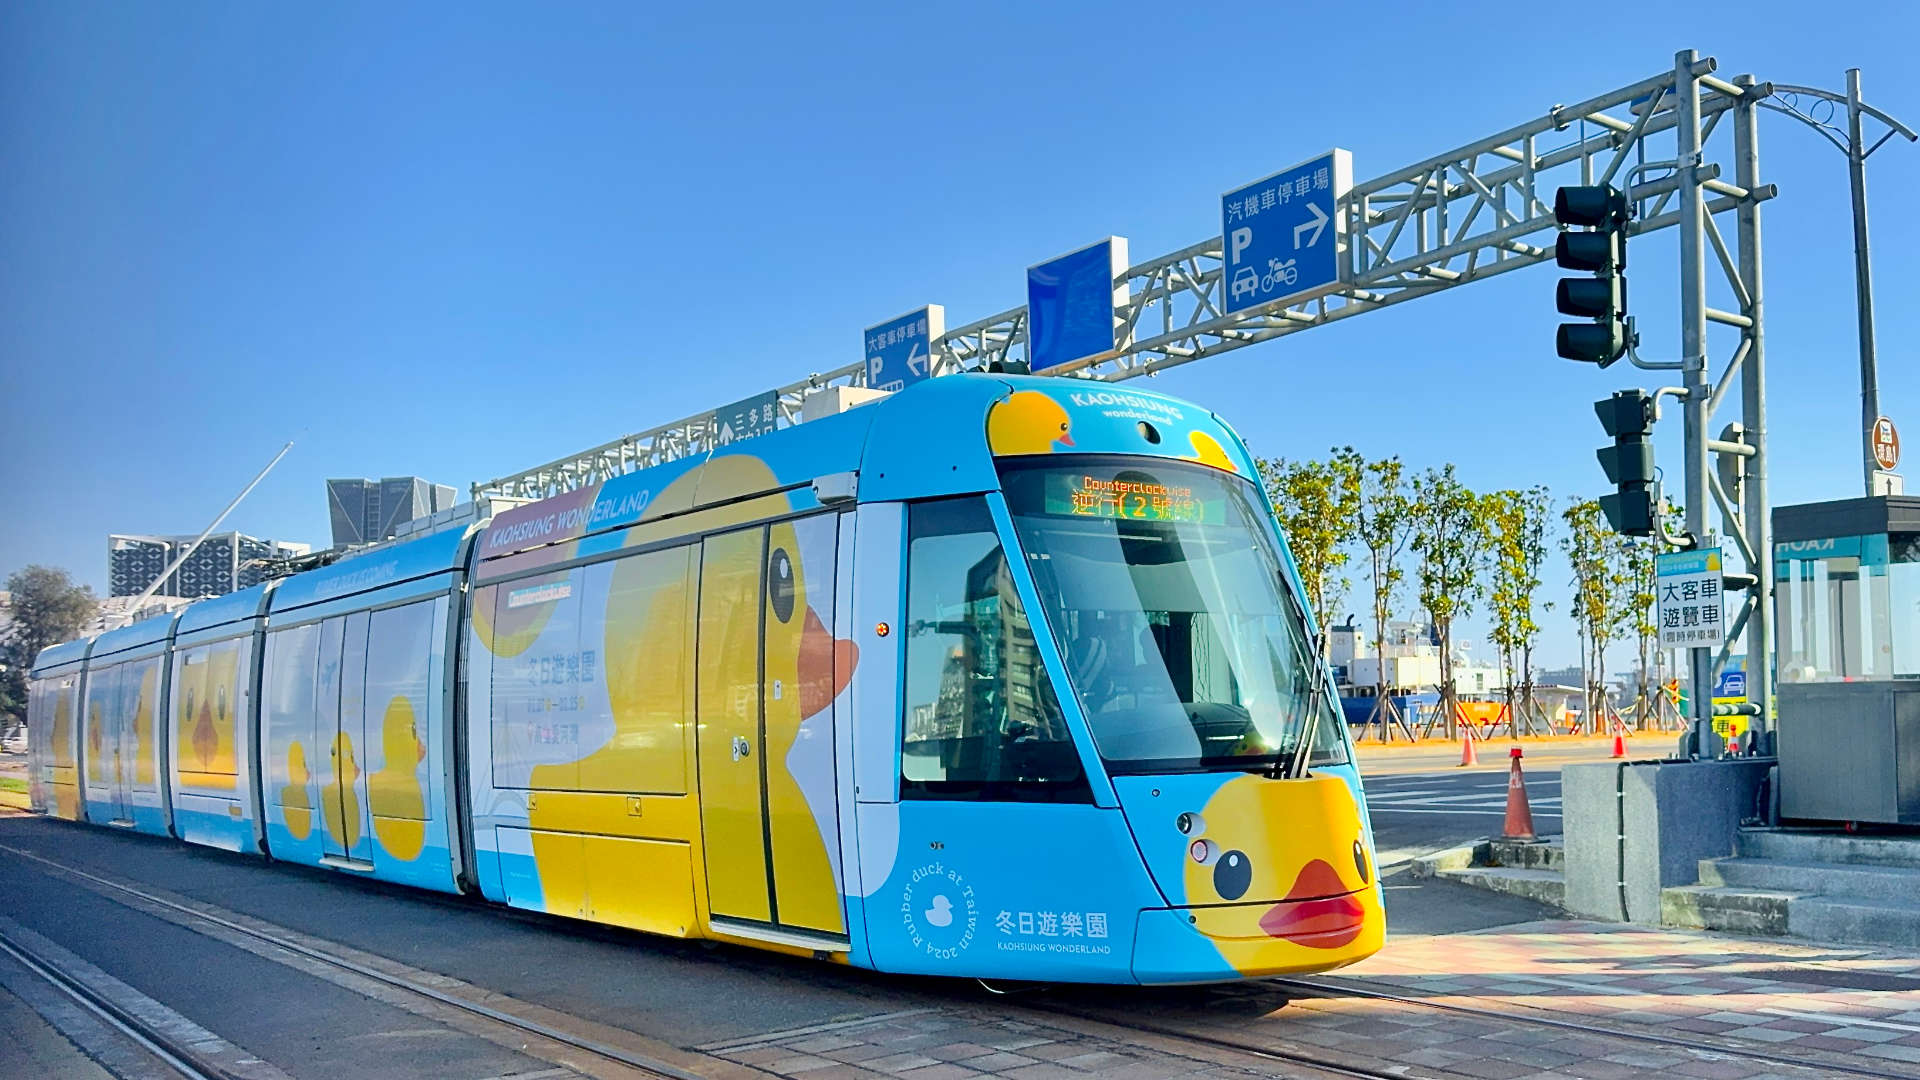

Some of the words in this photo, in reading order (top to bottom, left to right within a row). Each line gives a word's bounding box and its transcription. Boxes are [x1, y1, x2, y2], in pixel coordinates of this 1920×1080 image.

[1228, 167, 1329, 225] 汽機車停車場
[1231, 226, 1253, 265] P
[870, 356, 883, 385] P
[735, 403, 773, 431] 三多路
[1070, 393, 1184, 420] KAOHSIUNG
[1102, 408, 1173, 426] wonderland
[1084, 476, 1191, 497] Counterclockwise
[489, 514, 555, 549] KAOHSIUNG
[556, 490, 650, 530] WONDERLAND
[1663, 579, 1718, 603] 大客車
[1663, 604, 1720, 628] 遊覽車
[912, 861, 944, 883] duck
[947, 869, 964, 886] at
[901, 883, 923, 948] Rubber
[959, 885, 979, 950] Taiwan
[995, 909, 1109, 938] 冬日遊樂園
[926, 941, 959, 960] 2024
[997, 942, 1046, 952] KAOHSIUNG
[1048, 943, 1111, 955] WONDERLAND
